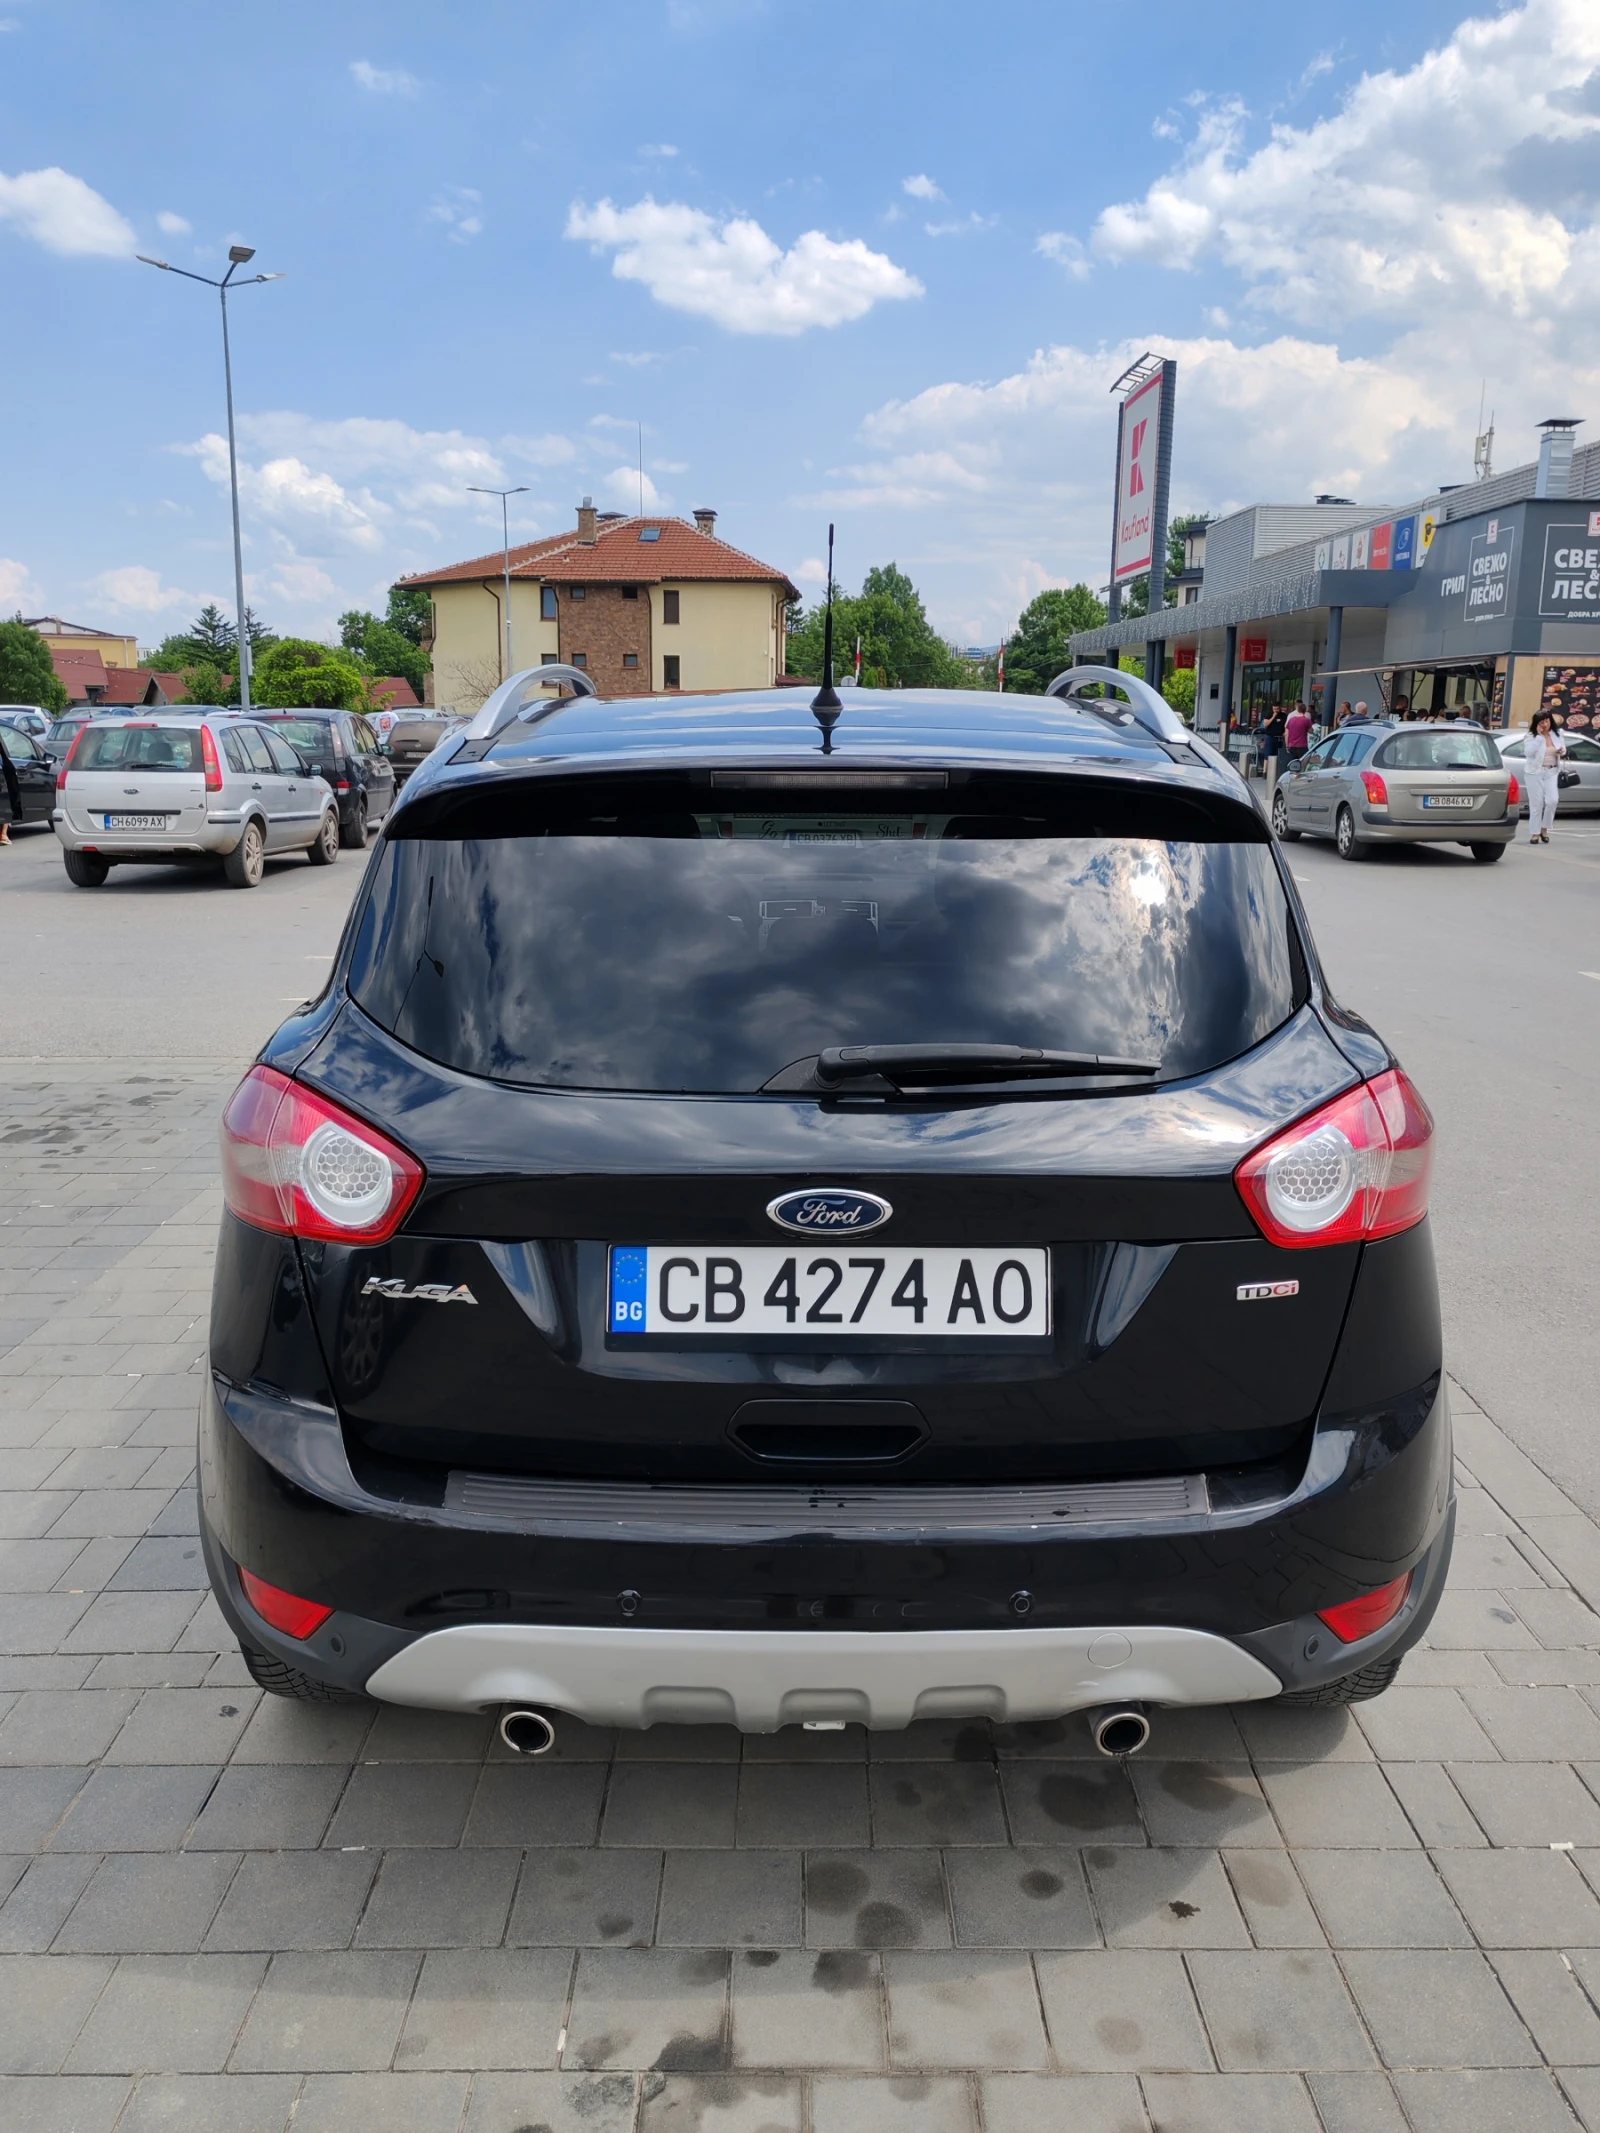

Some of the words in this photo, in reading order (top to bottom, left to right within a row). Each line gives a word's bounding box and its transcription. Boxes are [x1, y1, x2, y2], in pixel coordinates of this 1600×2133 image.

[1120, 507, 1150, 544] Kaufland
[1472, 552, 1507, 577] СВЕЖО
[1554, 548, 1600, 568] СВЕ
[1441, 575, 1466, 597] ГРИЛ
[1469, 582, 1504, 606] ЛЕСНО
[1551, 580, 1600, 599] ЛЕС
[111, 817, 124, 827] CH
[125, 817, 148, 827] 6099
[150, 817, 163, 827] AX
[797, 1199, 861, 1225] Ford
[361, 1276, 479, 1305] KUGA
[659, 1257, 746, 1323] CB
[763, 1257, 928, 1324] 4274
[947, 1258, 1033, 1324] AO
[1239, 1282, 1297, 1299] TDCi
[615, 1301, 643, 1321] BG
